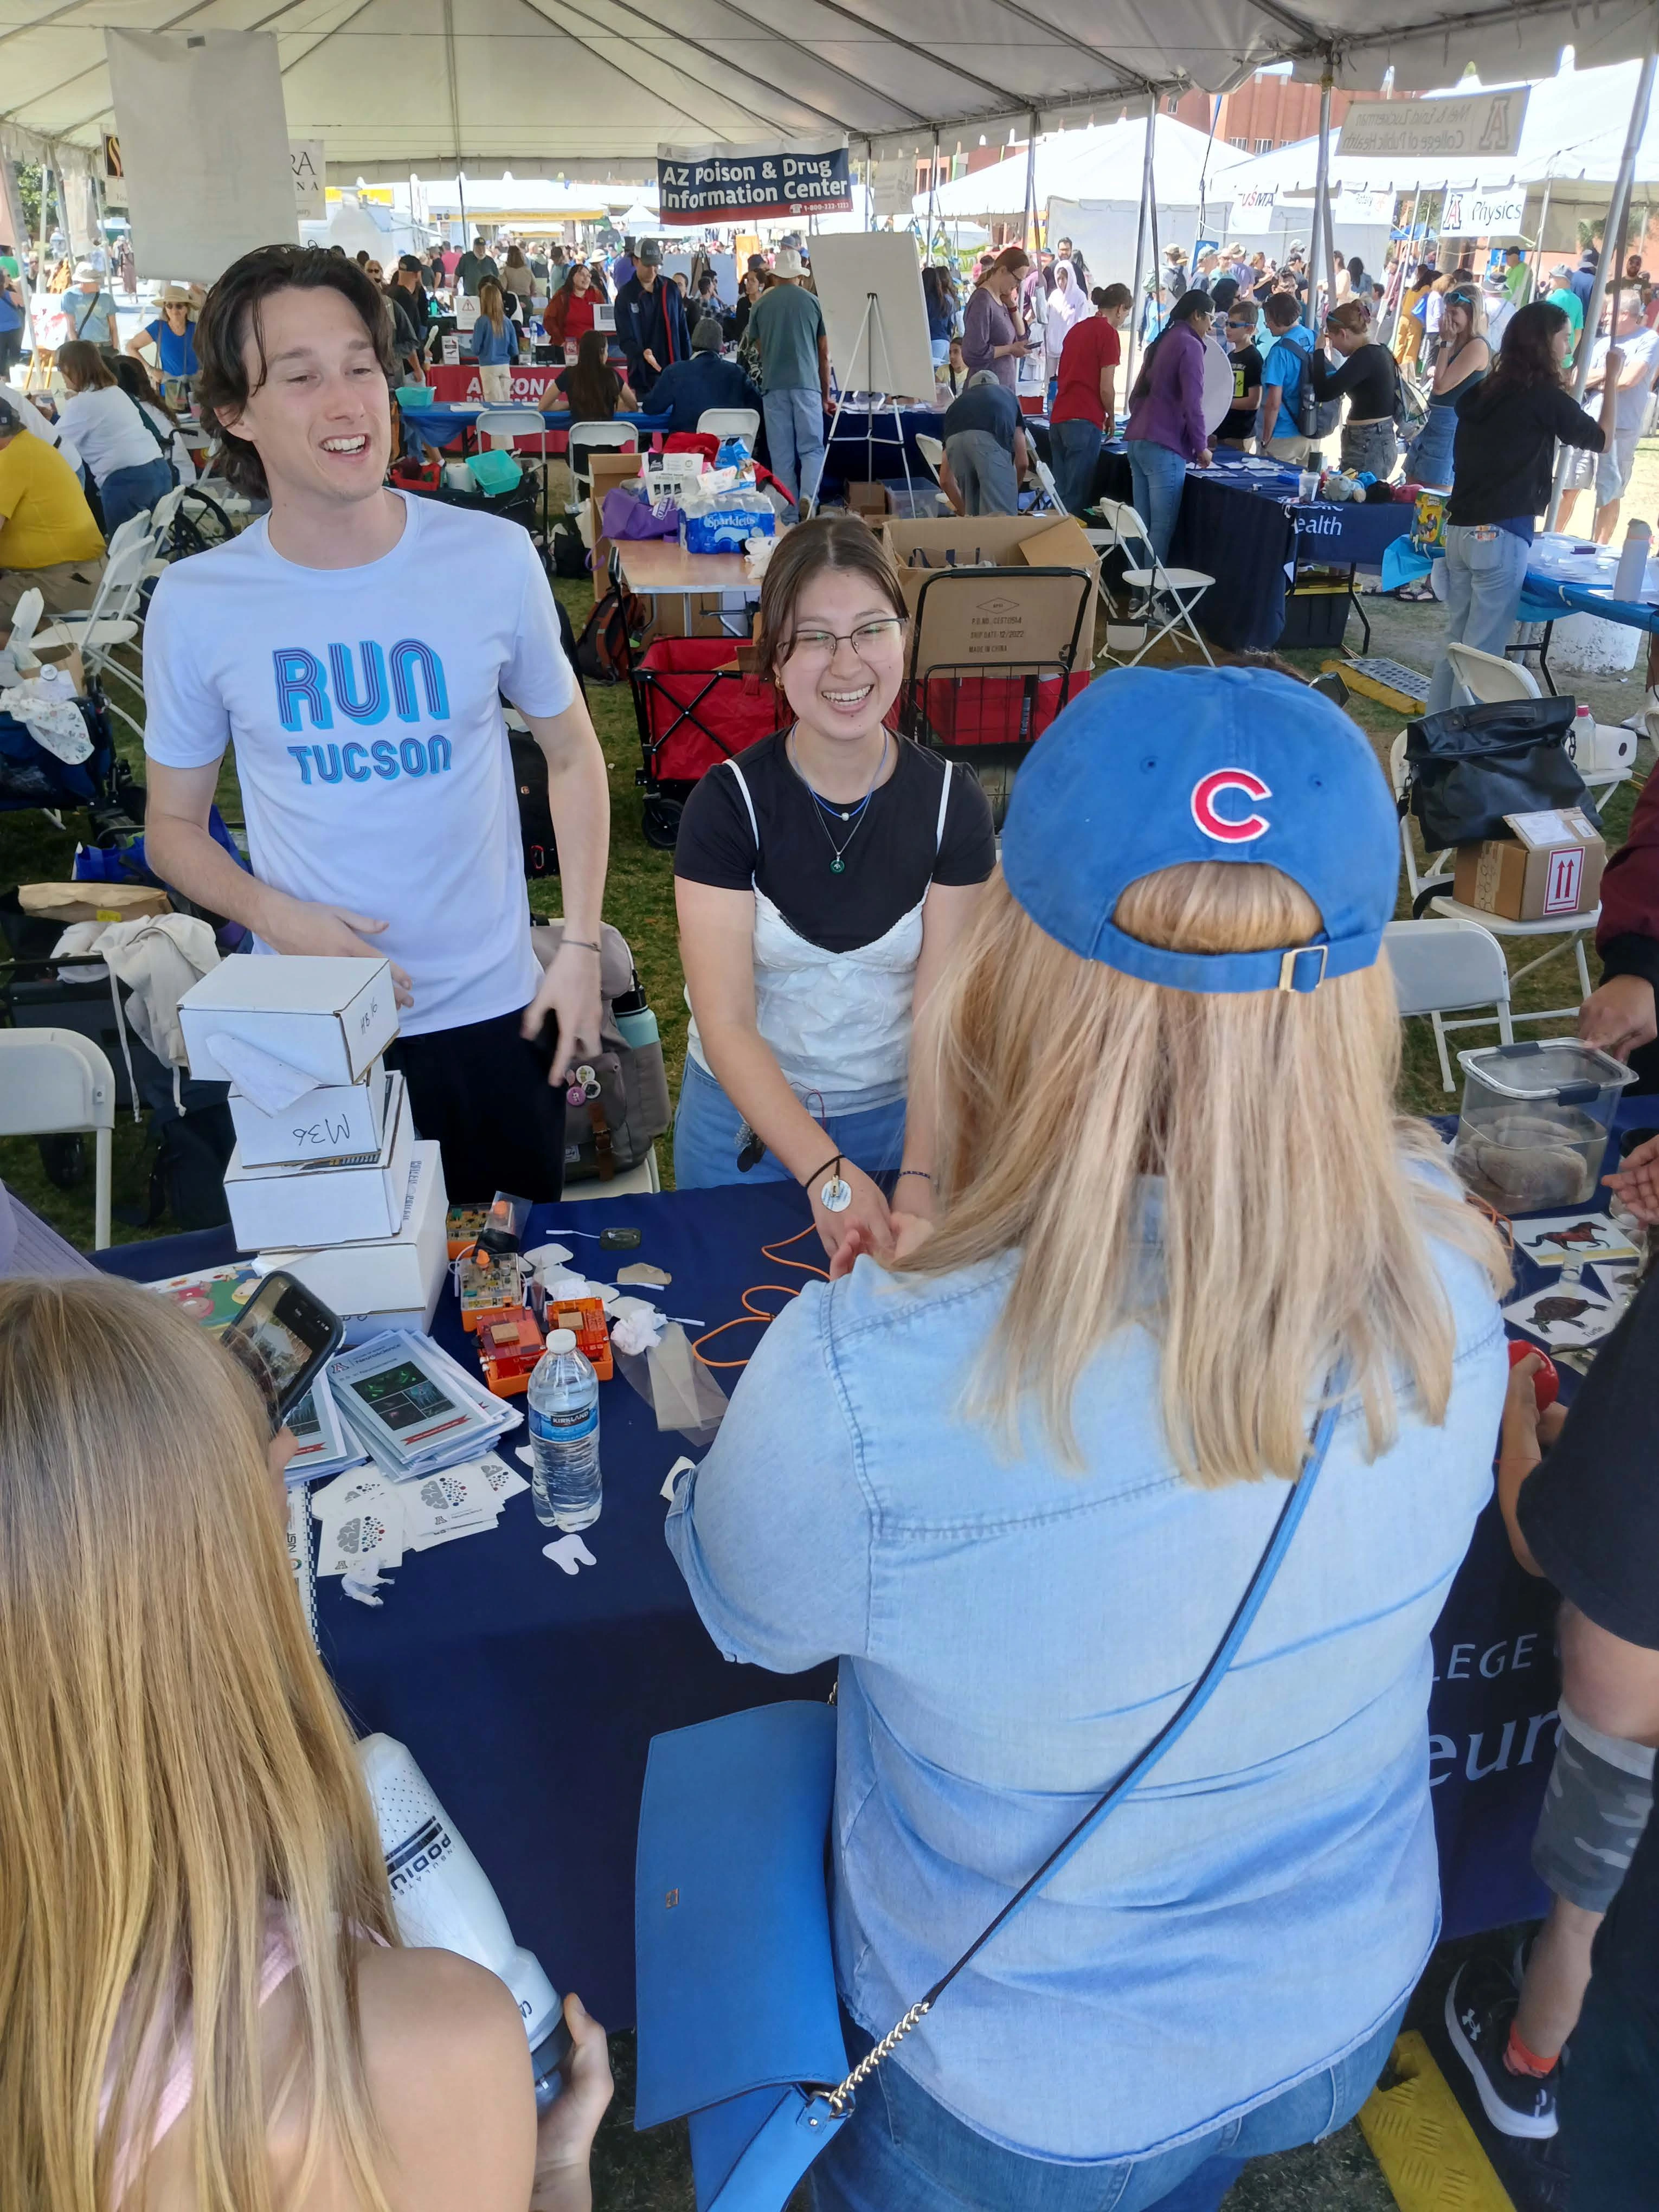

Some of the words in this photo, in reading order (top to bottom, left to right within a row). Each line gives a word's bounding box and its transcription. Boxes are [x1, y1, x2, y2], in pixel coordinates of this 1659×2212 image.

[663, 166, 690, 186] AZ
[762, 162, 777, 179] &
[782, 158, 832, 178] Drug
[662, 183, 778, 209] Information
[784, 178, 847, 200] Center
[1443, 194, 1463, 230] A
[1472, 201, 1522, 226] Physics
[273, 638, 451, 732] RUN
[287, 735, 452, 785] TUCSON
[1191, 767, 1272, 844] C
[293, 1113, 350, 1146] M36
[552, 1411, 589, 1423] KIRKLAND
[287, 1532, 297, 1553] NIST
[1433, 1633, 1538, 1681] EGE
[1429, 1709, 1564, 1787] eur
[389, 1833, 452, 1891] PODIU
